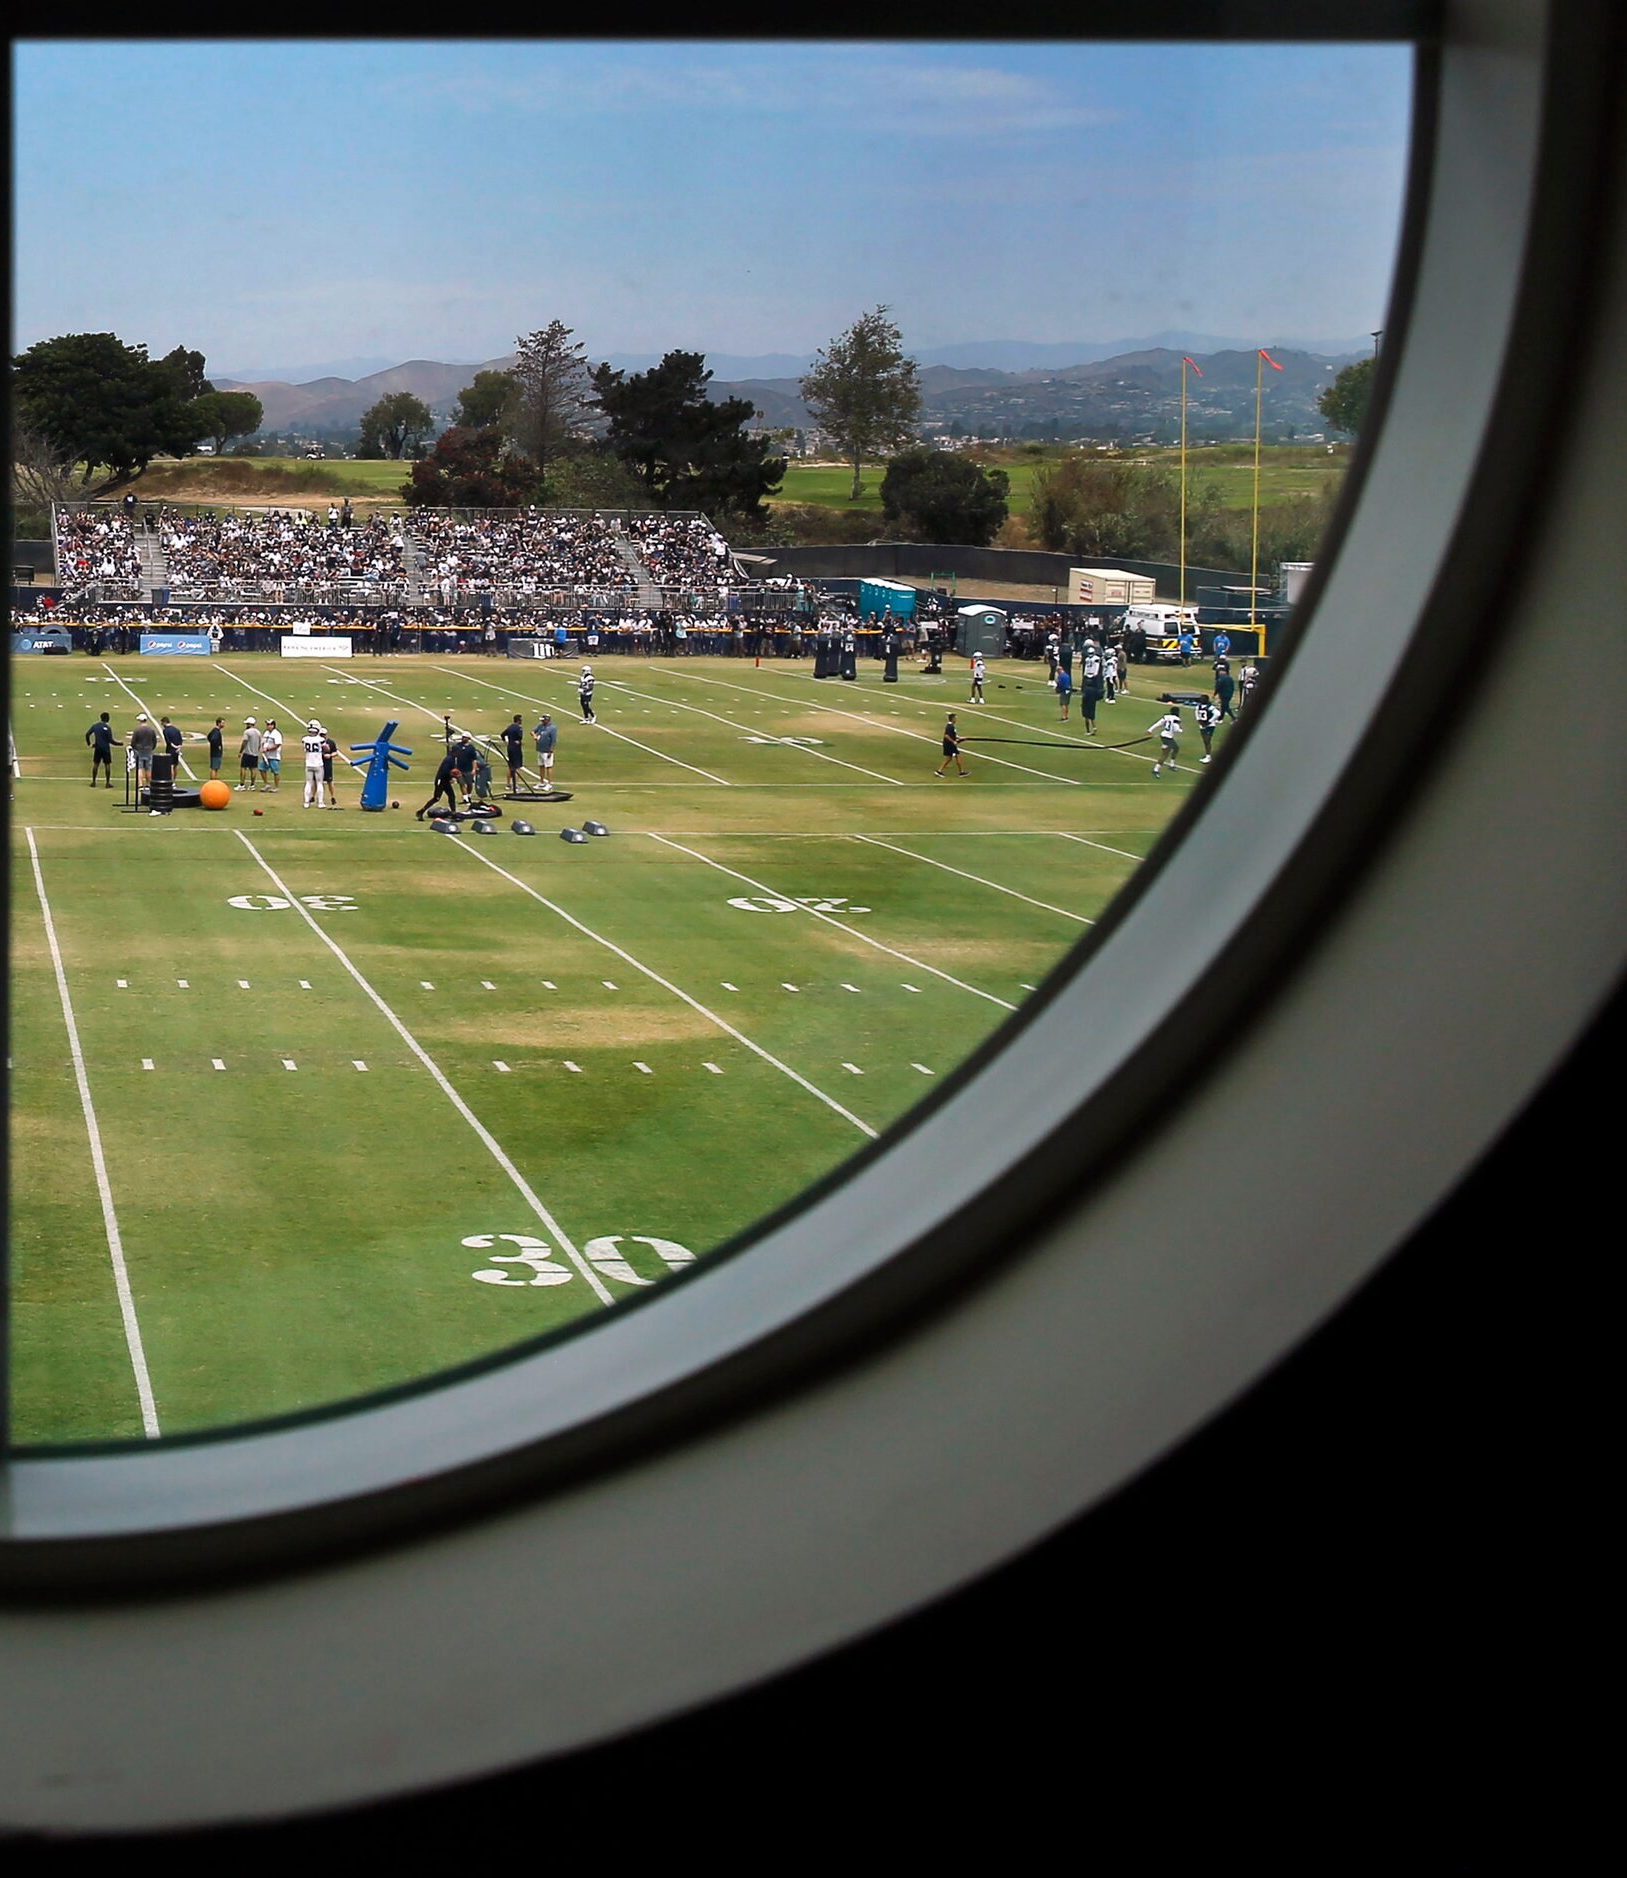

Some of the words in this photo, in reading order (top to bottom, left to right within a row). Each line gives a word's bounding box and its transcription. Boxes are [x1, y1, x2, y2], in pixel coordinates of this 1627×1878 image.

[304, 742, 320, 754] 86
[227, 895, 359, 911] 30
[726, 897, 872, 913] 20
[461, 1233, 698, 1287] 30
